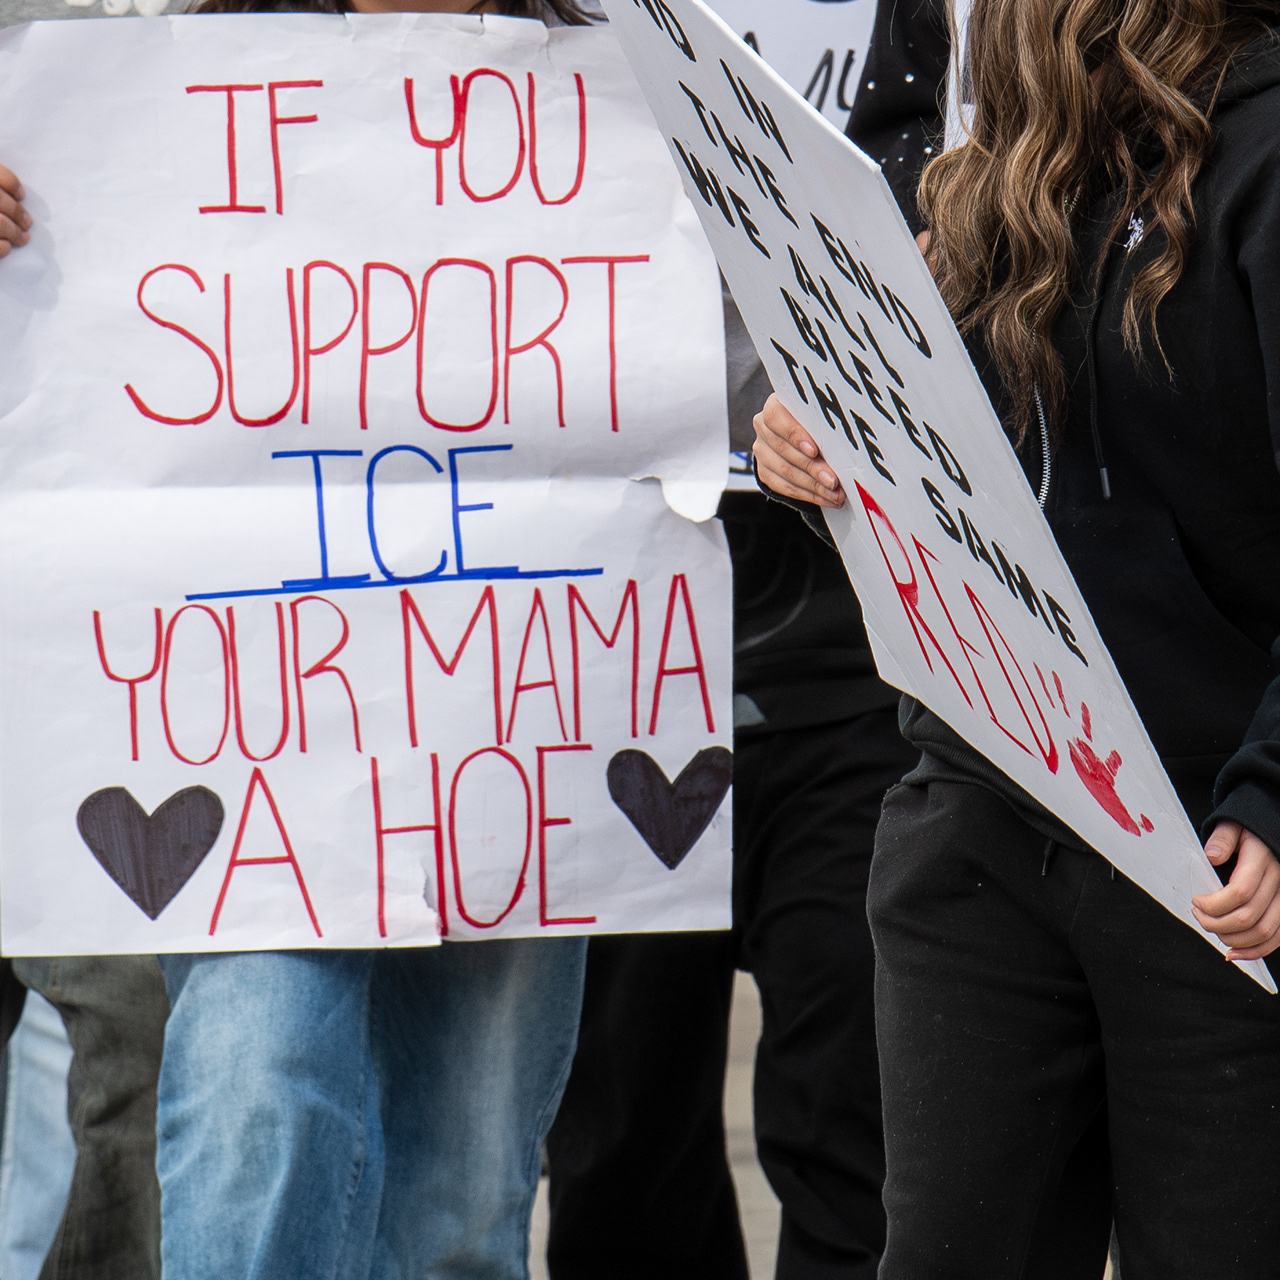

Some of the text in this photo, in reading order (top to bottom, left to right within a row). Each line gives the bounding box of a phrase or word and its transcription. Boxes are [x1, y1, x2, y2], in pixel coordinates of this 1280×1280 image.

[185, 80, 324, 215] IF
[403, 67, 587, 206] YOU
[720, 58, 794, 165] IN
[672, 136, 904, 388] WE ALL
[678, 80, 933, 359] THE END
[124, 254, 650, 432] SUPPORT
[778, 285, 973, 498] BLEED
[271, 443, 520, 586] ICE
[770, 336, 1089, 668] THE SAME
[92, 573, 715, 765] YOUR MAMA
[854, 478, 1059, 776] RED
[208, 743, 598, 938] A HOE
